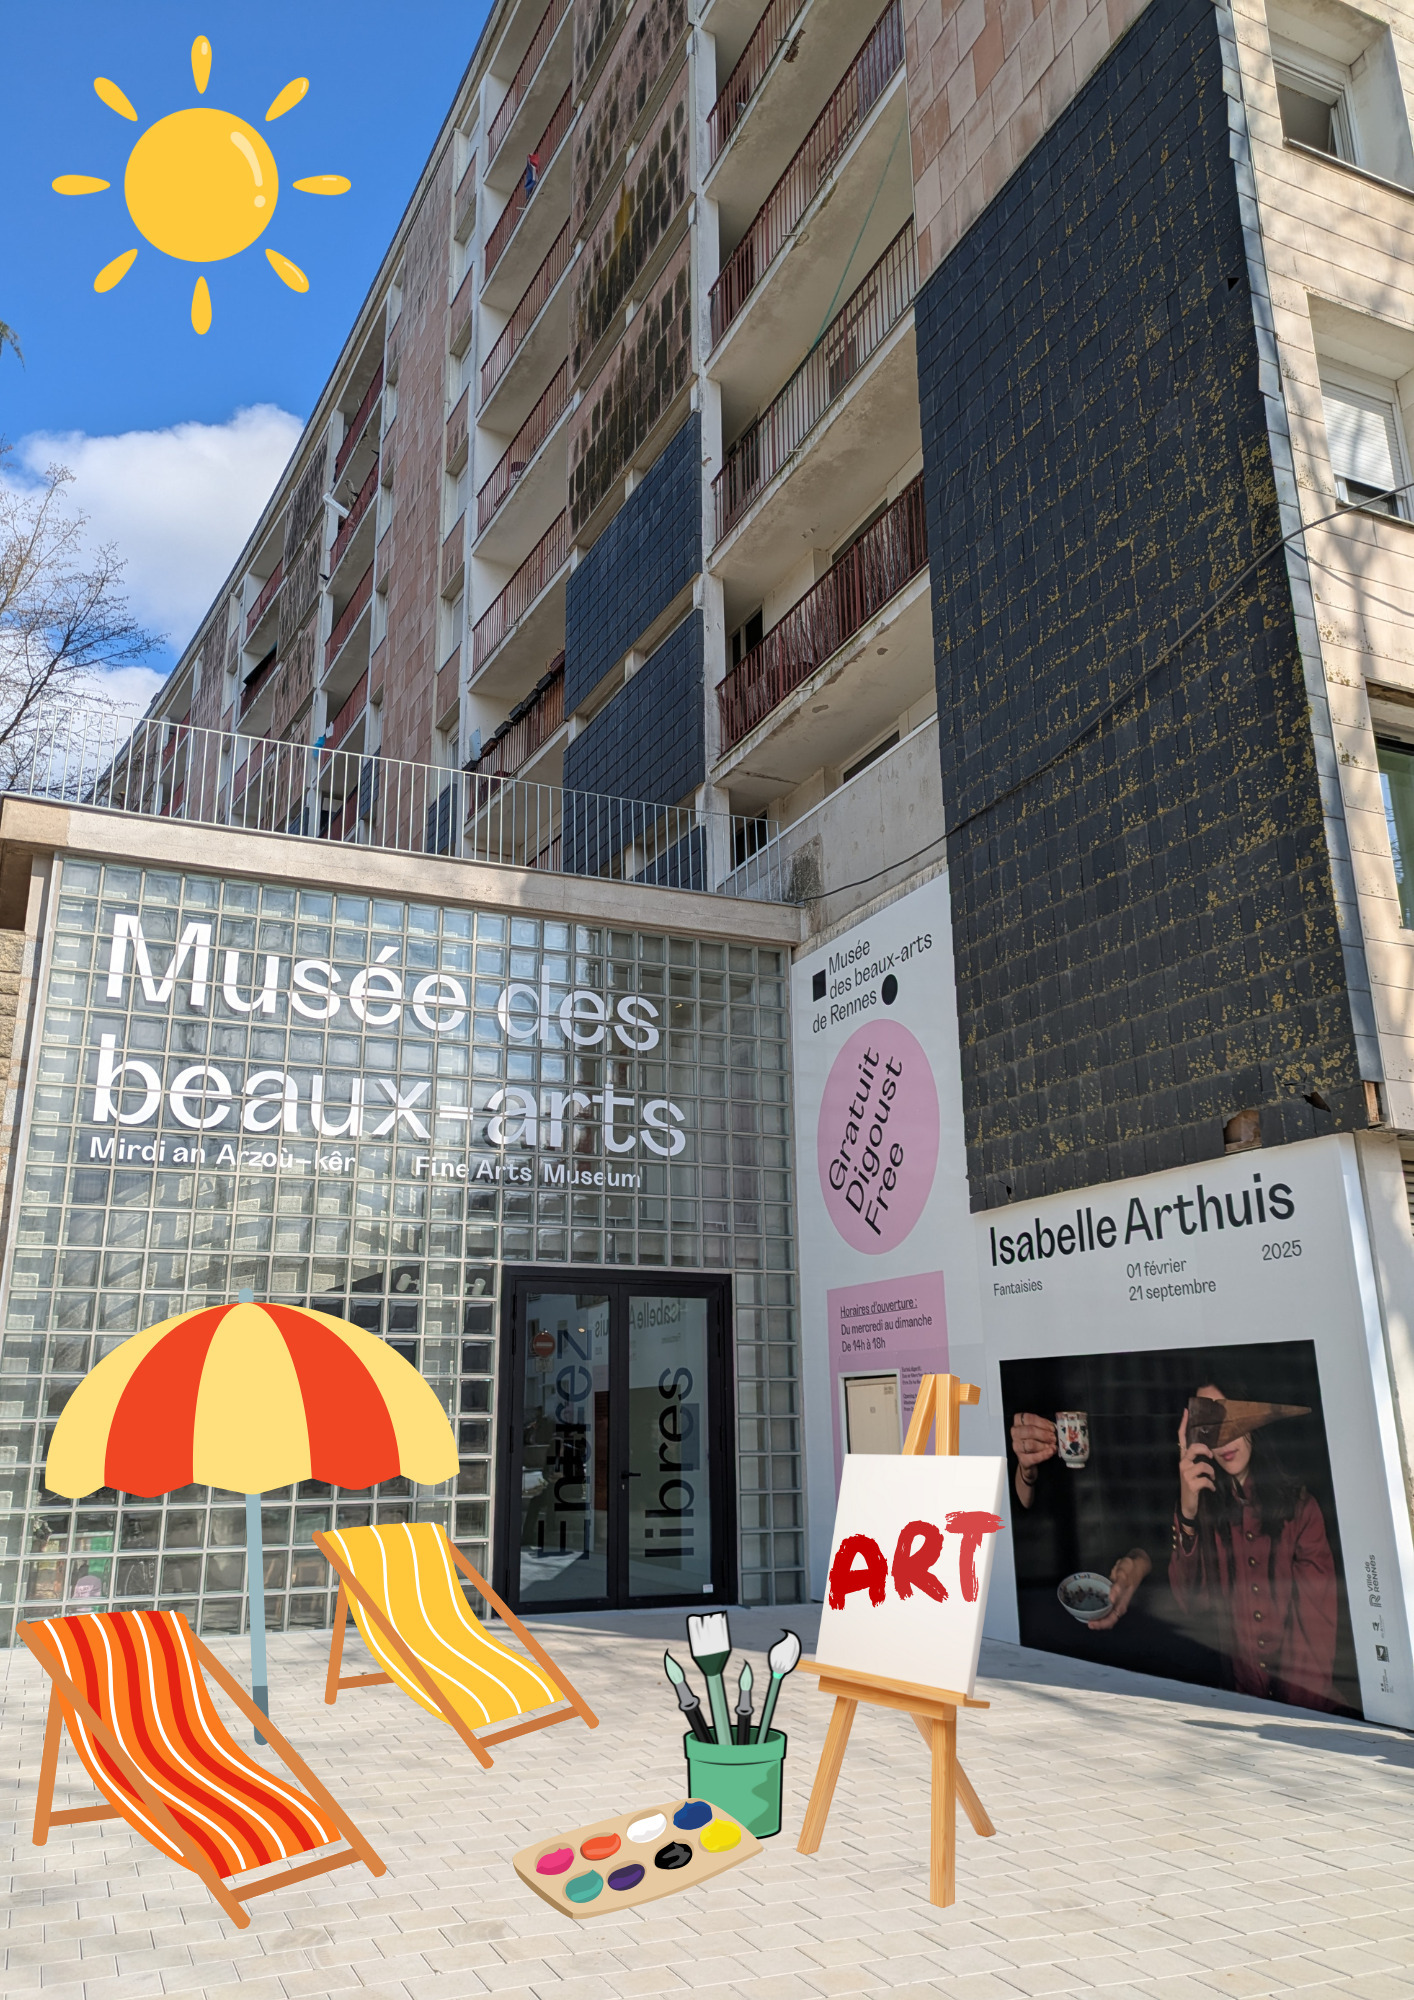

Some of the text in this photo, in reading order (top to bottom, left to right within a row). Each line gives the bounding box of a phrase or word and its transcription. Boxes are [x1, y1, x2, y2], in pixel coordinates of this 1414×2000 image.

[829, 939, 870, 975] Musée
[829, 933, 933, 999] des beaux-arts
[105, 912, 661, 1052] Musée des
[812, 990, 877, 1033] de Rennes
[92, 1033, 687, 1158] beaux-arts
[829, 1046, 880, 1191] Gratuit
[845, 1056, 903, 1214] Digoust
[90, 1136, 165, 1162] Mirdi
[172, 1144, 205, 1164] an
[415, 1156, 641, 1188] Fine Arts Museum
[865, 1142, 904, 1236] Free
[989, 1173, 1296, 1267] Isabelle Arthuis
[1126, 1258, 1187, 1278] 01 février
[1262, 1240, 1303, 1261] 2025
[993, 1278, 1043, 1297] Fantaisies
[1129, 1278, 1217, 1302] 21 septembre
[840, 1304, 870, 1318] Horaires
[841, 1313, 933, 1335] Du mercredi au dimanche
[841, 1337, 886, 1352] De 14h à 18h
[644, 1367, 695, 1558] libres
